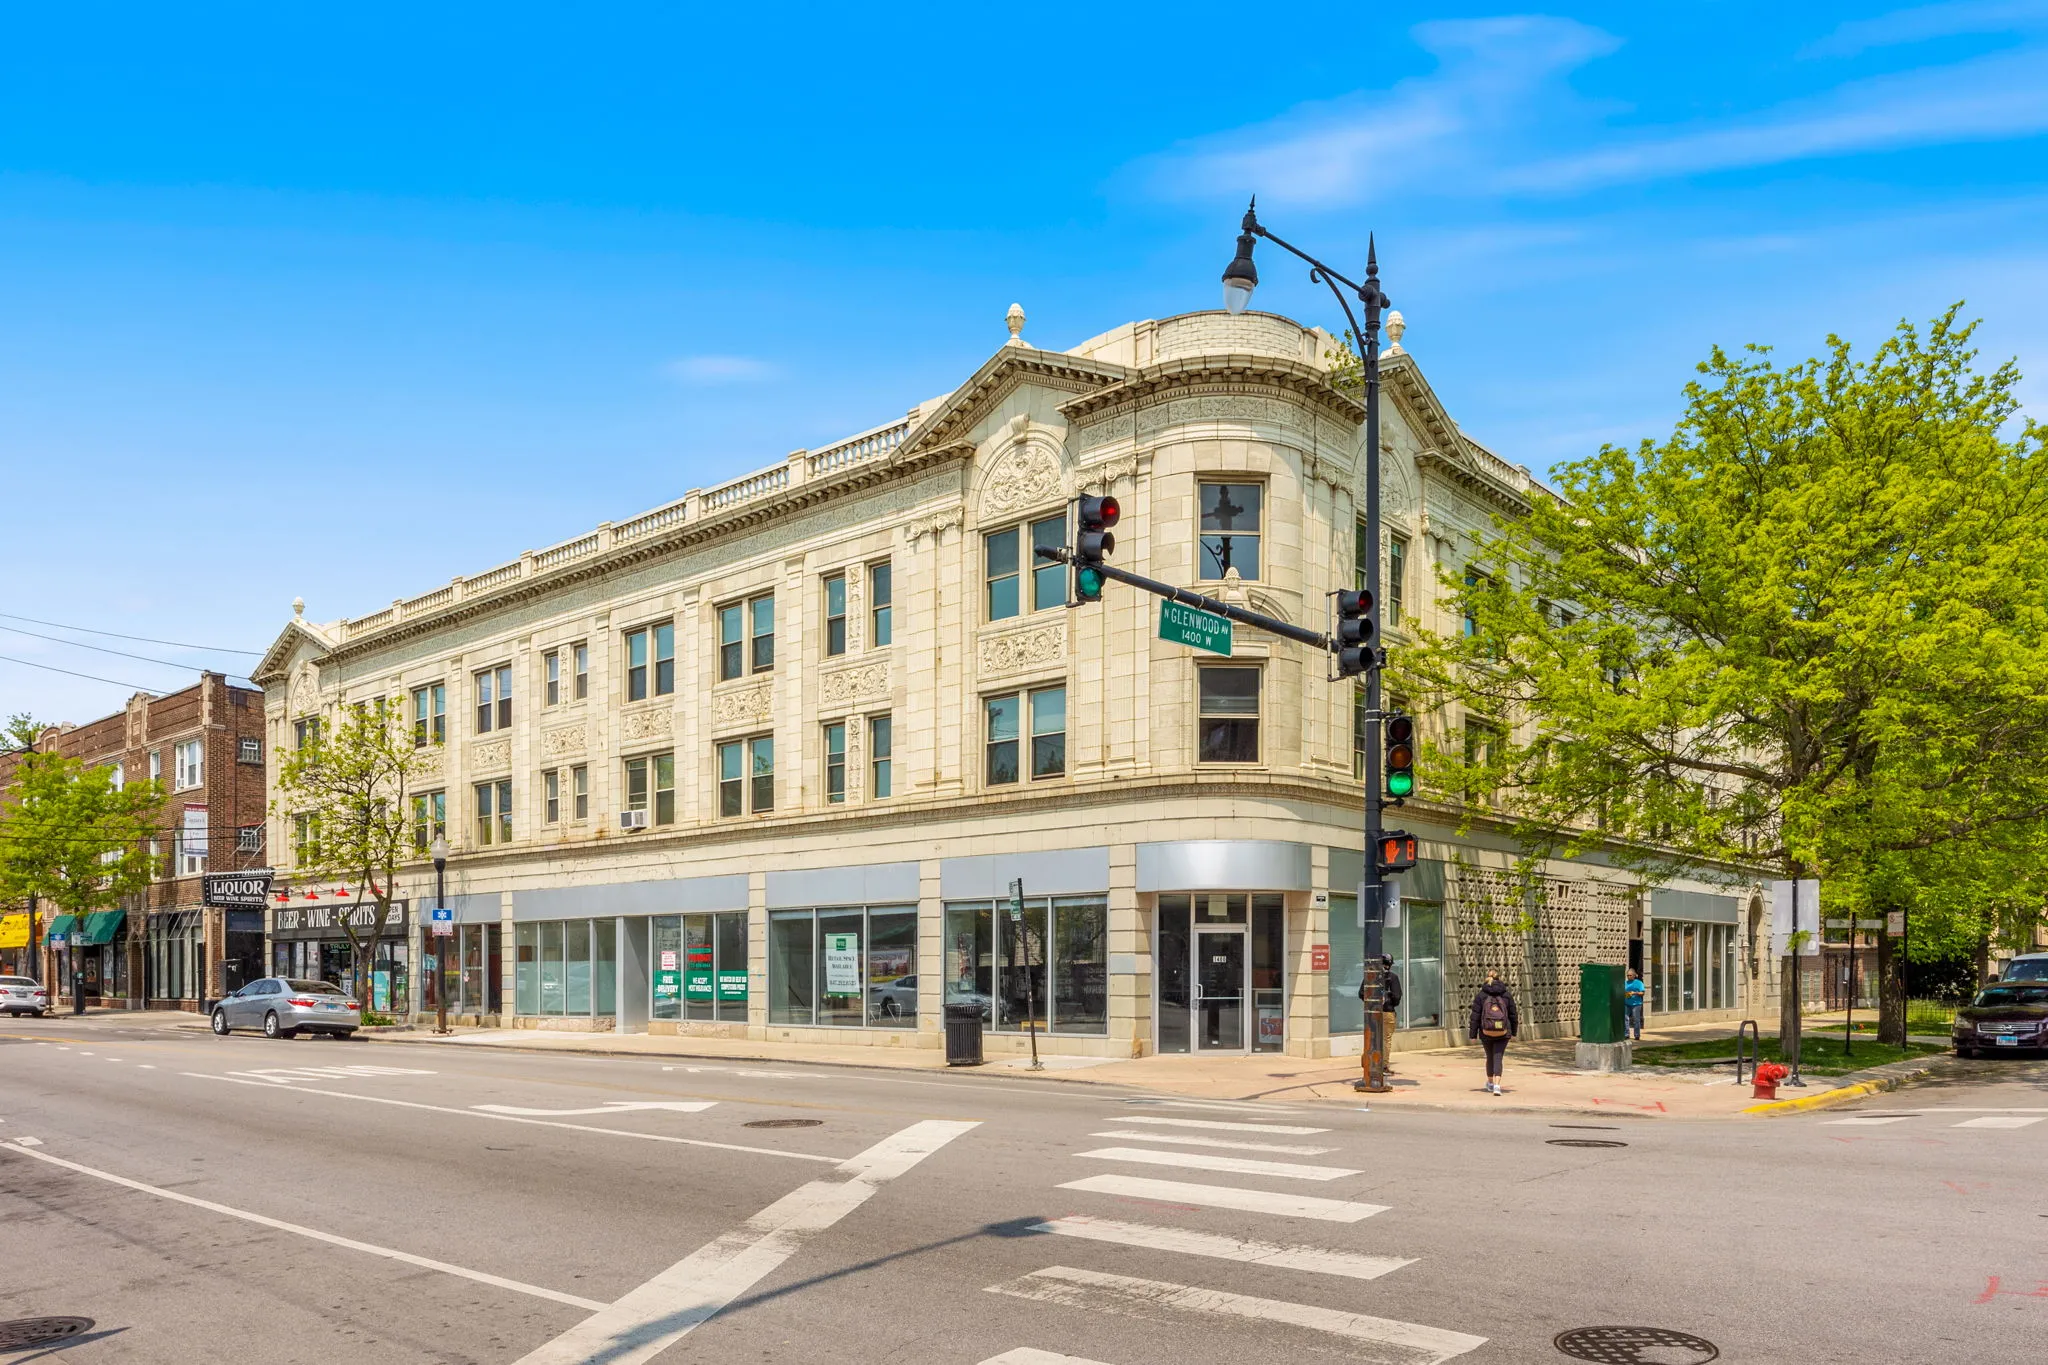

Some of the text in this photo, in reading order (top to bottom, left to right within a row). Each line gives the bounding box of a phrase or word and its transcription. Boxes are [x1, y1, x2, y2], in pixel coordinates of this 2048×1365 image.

[1164, 607, 1228, 635] N GLENWOOD AV
[1182, 629, 1212, 647] 1400 W
[213, 880, 265, 896] LIQUOR
[277, 910, 300, 930] BEER
[307, 908, 331, 928] WINE
[662, 975, 674, 984] FREE
